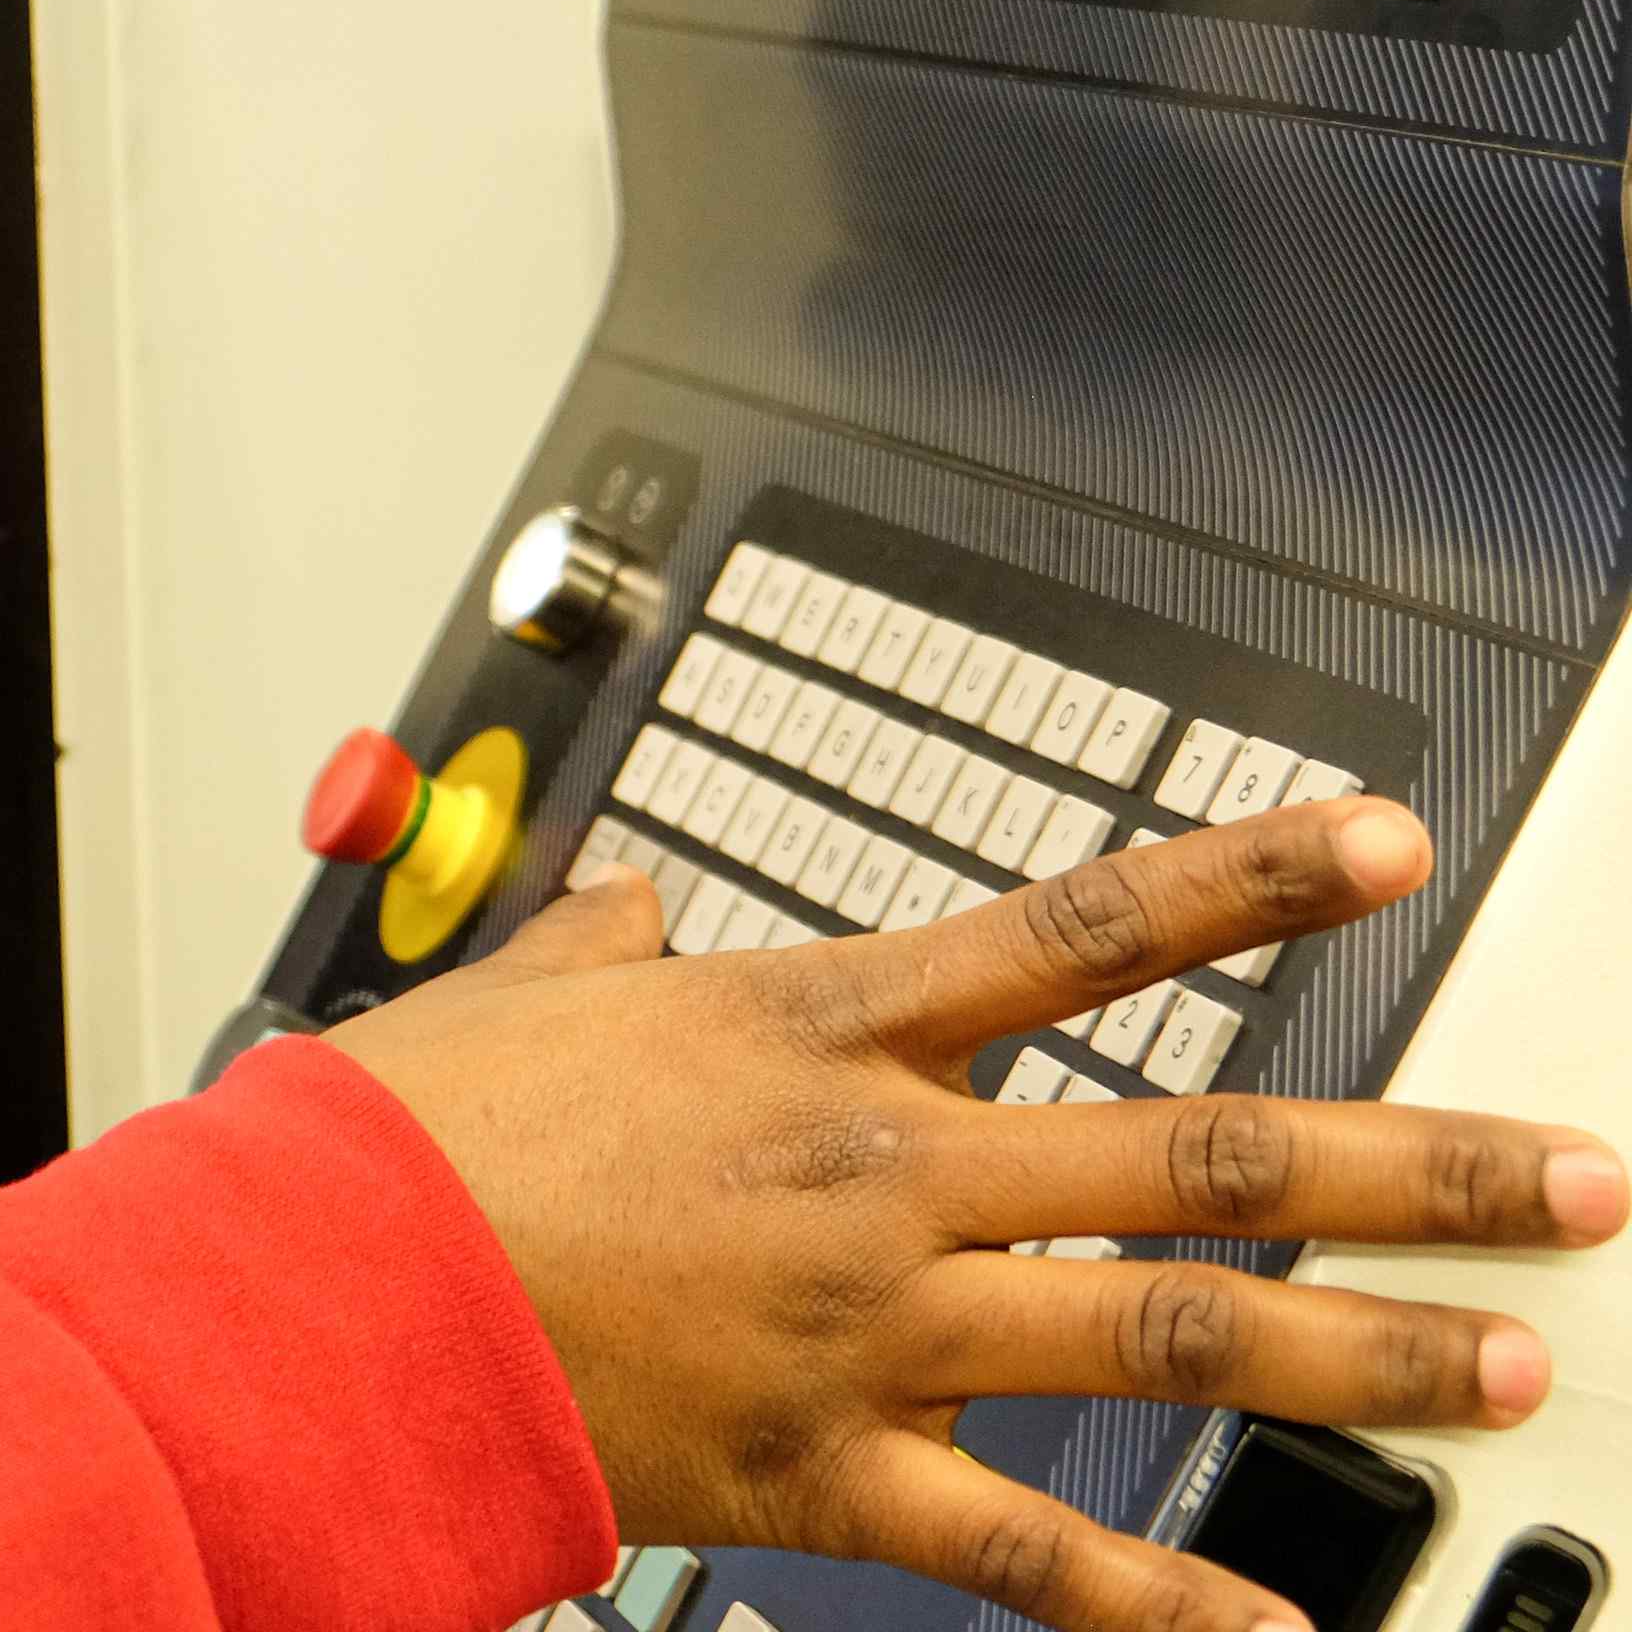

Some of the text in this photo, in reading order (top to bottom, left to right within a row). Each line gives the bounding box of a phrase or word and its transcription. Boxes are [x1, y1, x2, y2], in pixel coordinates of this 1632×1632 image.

[965, 665, 986, 693] U
[1056, 701, 1078, 732] O
[1104, 719, 1128, 748] P
[1182, 754, 1259, 804] 7 8
[1003, 807, 1020, 838] L
[1118, 999, 1193, 1059] 2 3
